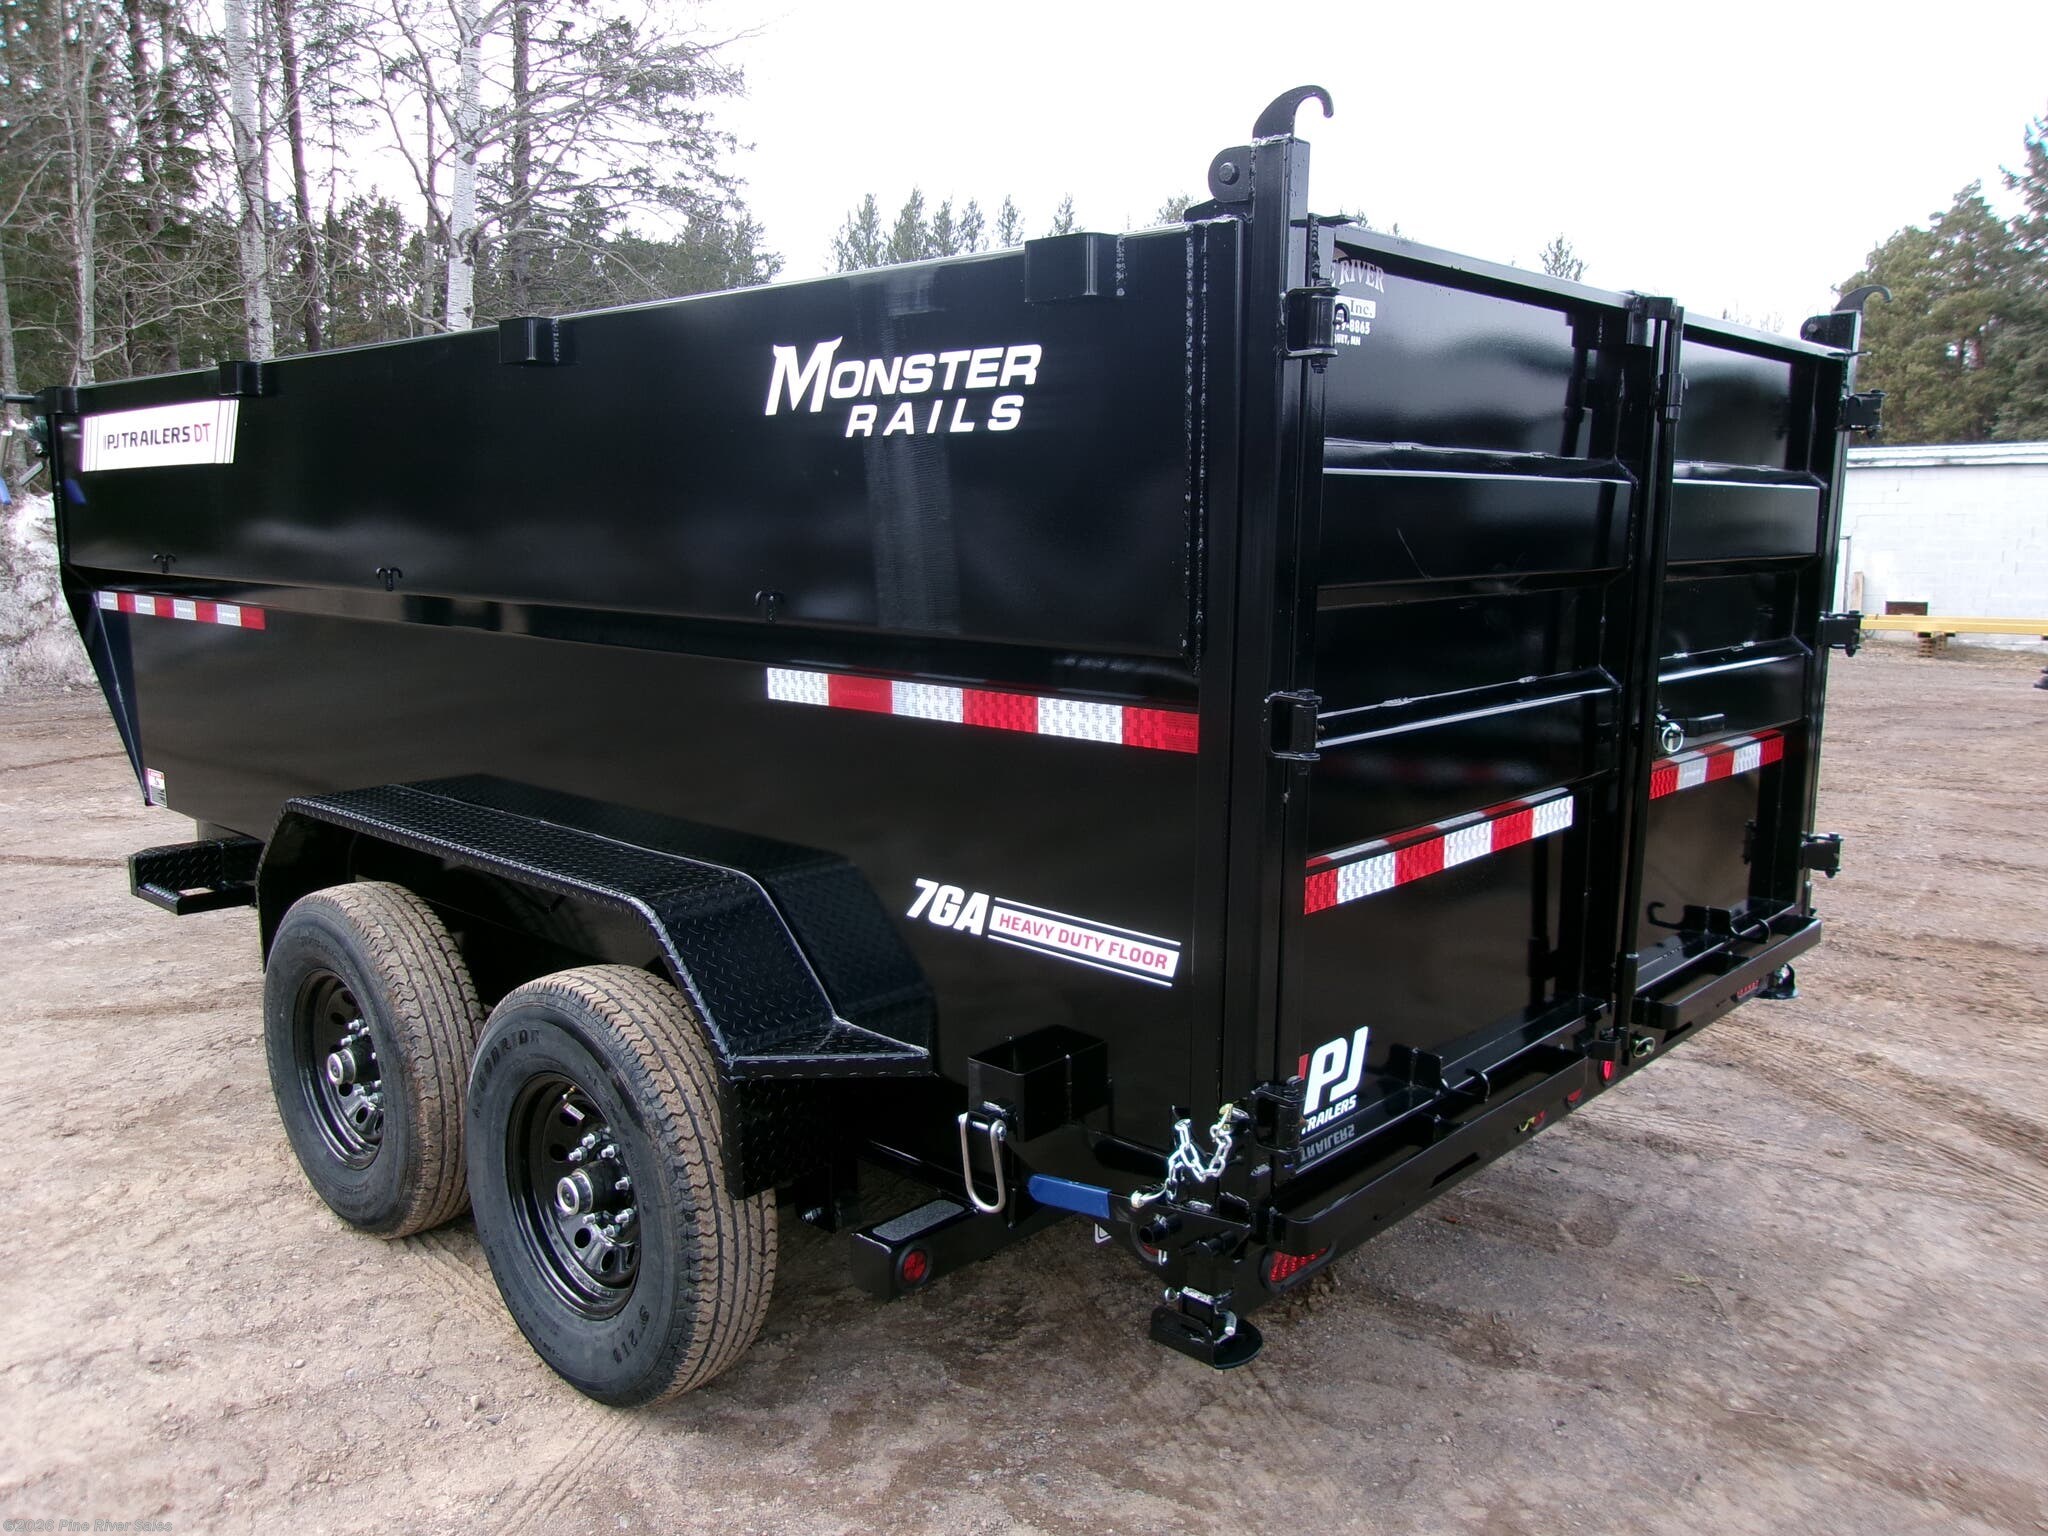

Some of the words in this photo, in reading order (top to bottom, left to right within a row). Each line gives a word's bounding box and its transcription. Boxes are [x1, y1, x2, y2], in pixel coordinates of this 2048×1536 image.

[1339, 259, 1385, 293] RIVER
[1349, 299, 1374, 317] Inc.
[764, 335, 1043, 416] MONSTER
[193, 422, 212, 442] DT
[845, 394, 1026, 438] RAILS
[906, 877, 990, 936] 7GA
[999, 913, 1055, 940] HEAVY
[1057, 928, 1106, 953] DUTY
[1108, 941, 1169, 970] FLOOR
[1303, 1025, 1369, 1116] PJ
